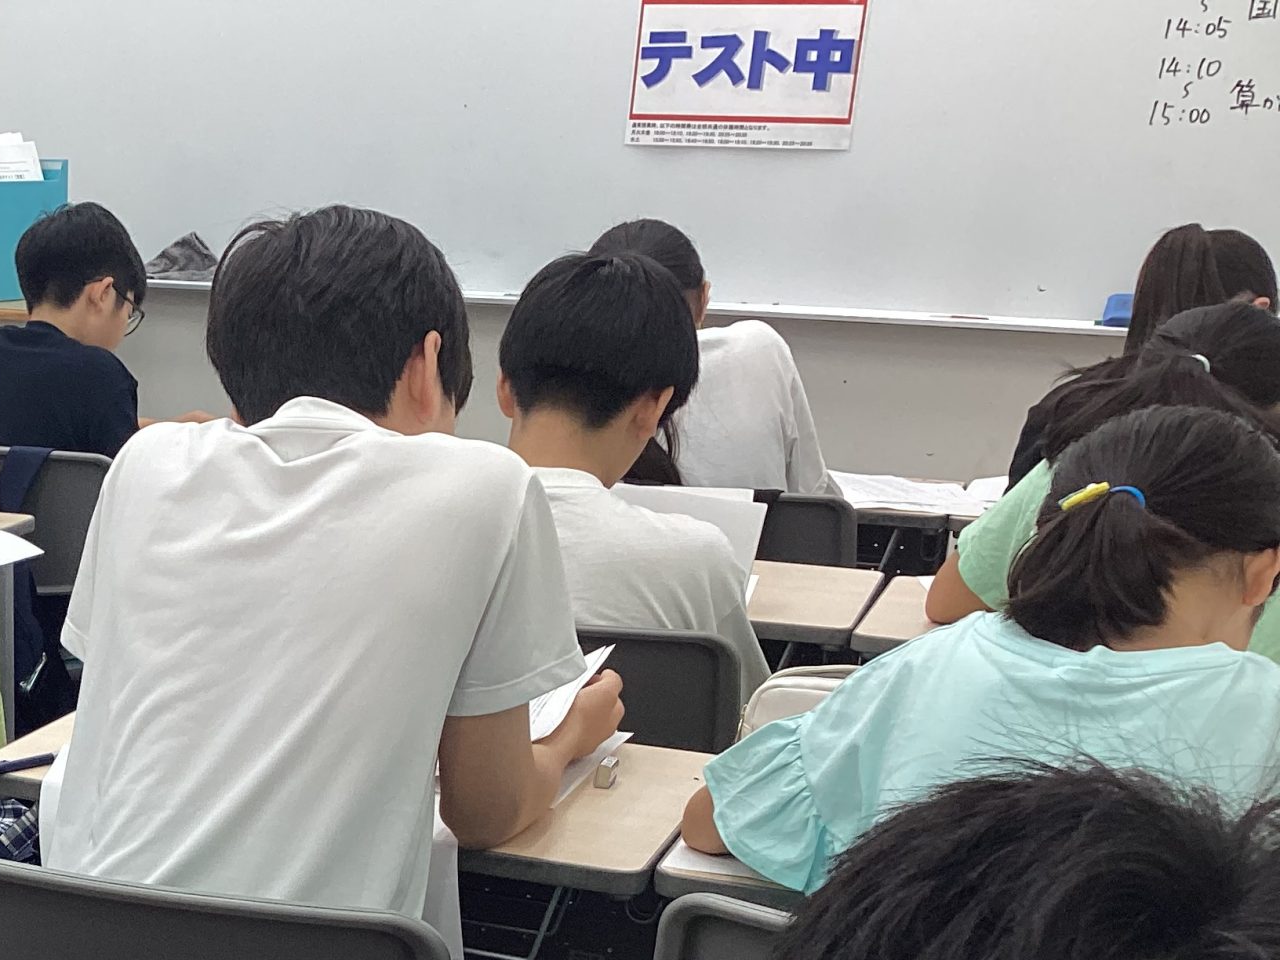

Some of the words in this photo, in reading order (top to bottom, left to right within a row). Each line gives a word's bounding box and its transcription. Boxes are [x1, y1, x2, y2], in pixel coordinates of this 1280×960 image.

[1164, 16, 1232, 39] 14:05
[641, 28, 856, 91] テスト中
[1158, 57, 1222, 80] 14:10
[1149, 100, 1210, 125] 15:00
